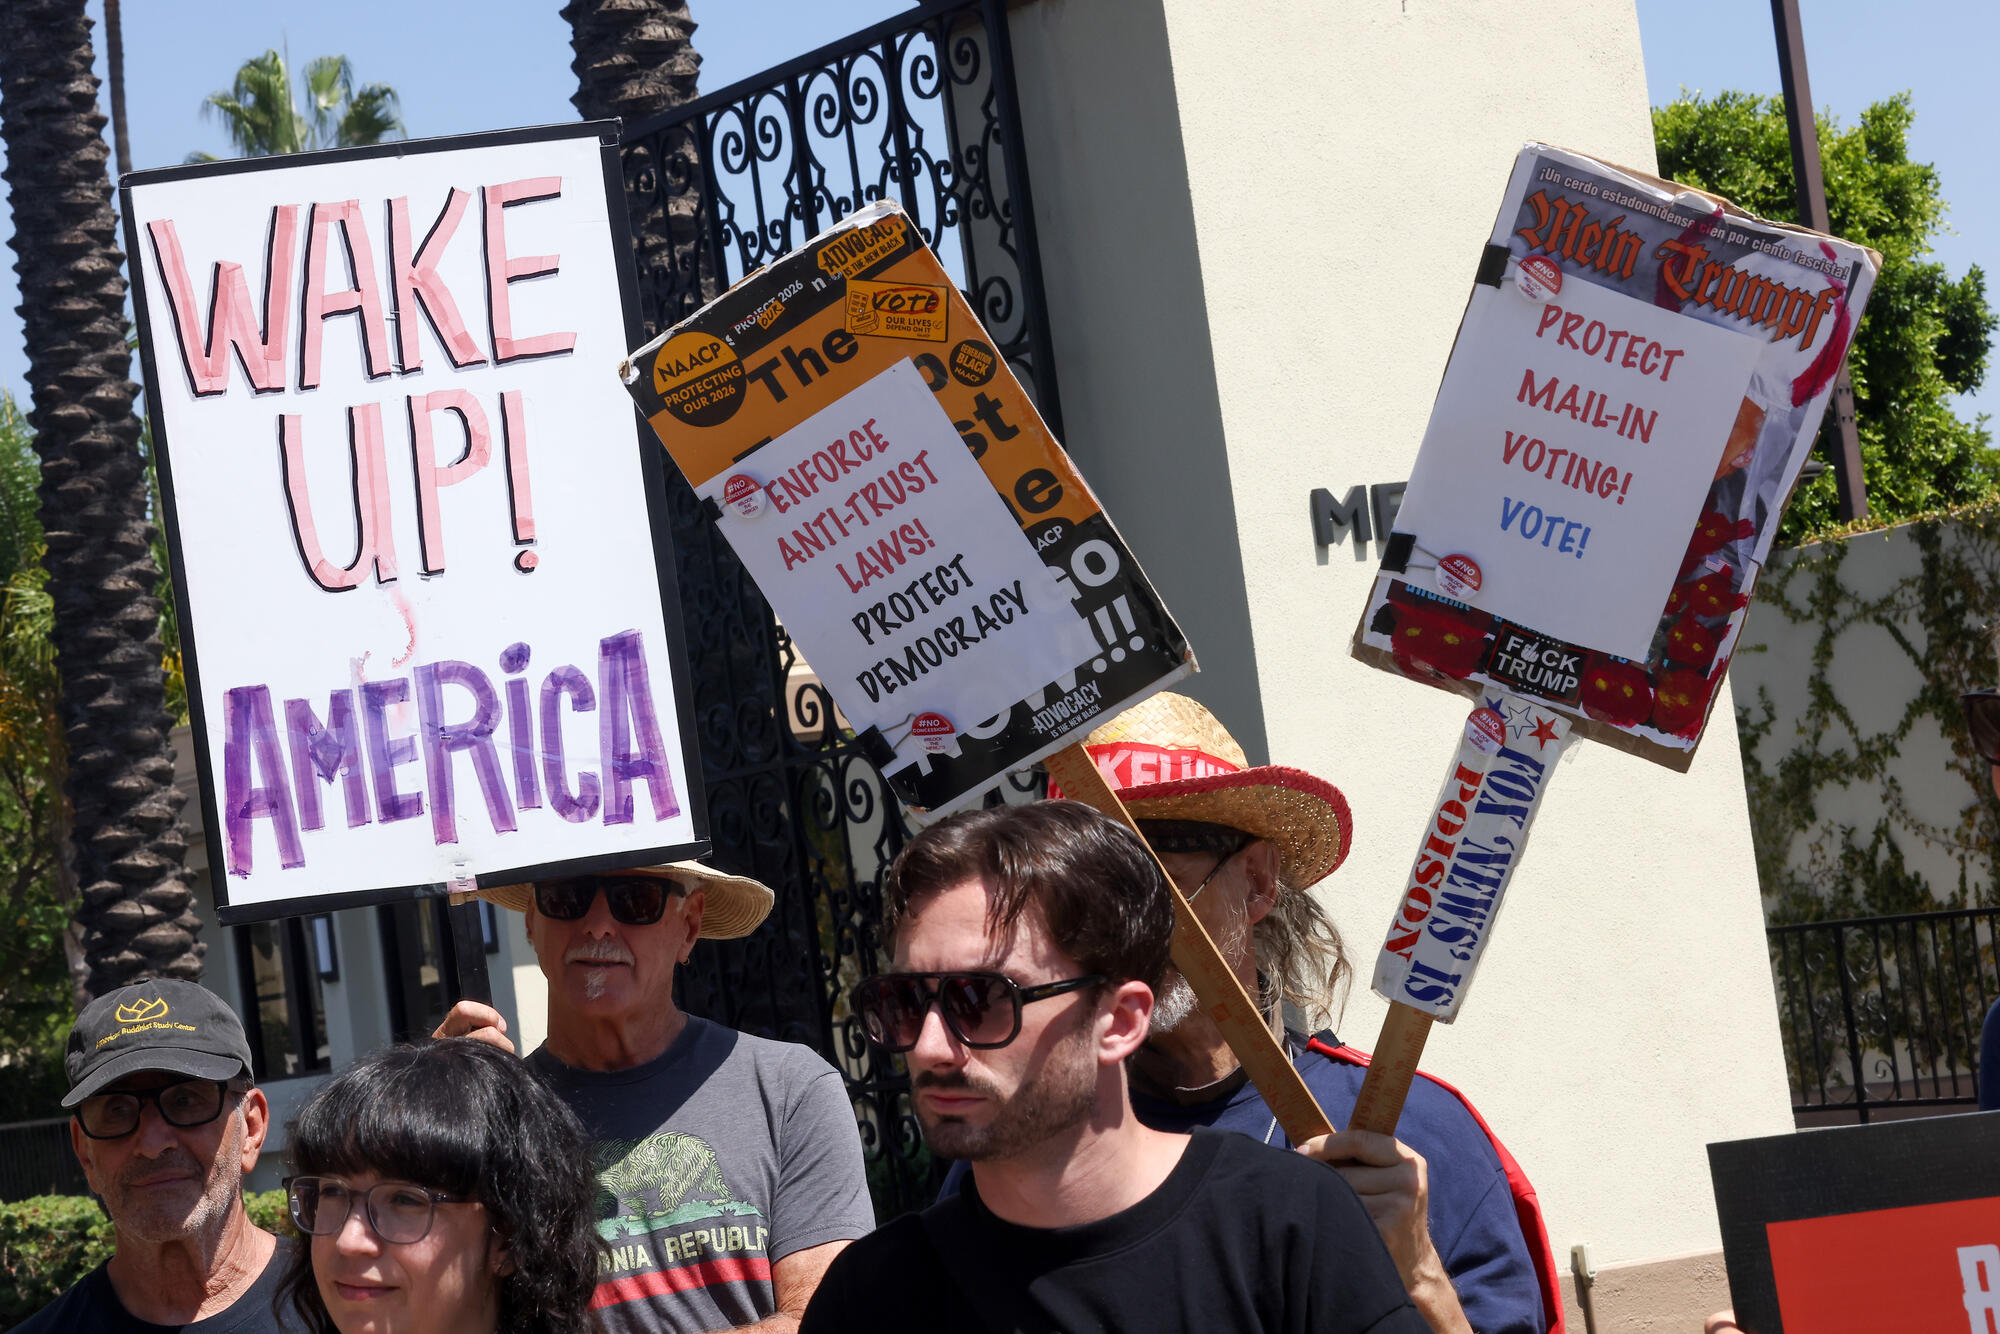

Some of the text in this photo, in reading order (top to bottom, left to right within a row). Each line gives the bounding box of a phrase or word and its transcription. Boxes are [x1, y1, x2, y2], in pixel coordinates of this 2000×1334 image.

[1539, 167, 1562, 185] ¡Un
[1564, 176, 1599, 196] cerdo
[1601, 187, 1696, 231] estadounidense
[1727, 229, 1751, 246] por
[1751, 237, 1791, 261] ciento
[1794, 249, 1851, 281] fascista!
[843, 236, 901, 277] IS THE NEW BLACK
[1515, 188, 1846, 353] Mein Trumpf
[147, 176, 578, 397] WAKE
[777, 279, 804, 303] 2026
[872, 291, 938, 314] VOTE
[761, 304, 784, 327] OUR
[886, 316, 932, 327] OUR LIVES
[886, 324, 911, 332] DEPEND
[657, 341, 721, 383] NAACP
[956, 352, 989, 377] BLACK
[1535, 304, 1685, 382] PROTECT
[664, 364, 742, 408] PROTECTING
[747, 328, 860, 404] The
[954, 366, 981, 383] NAACP
[683, 384, 736, 414] OUR 2026
[1516, 369, 1659, 444] MAIL-IN
[726, 479, 746, 493] #NO
[764, 418, 890, 514] ENFORCE
[1502, 430, 1634, 505] VOTING!
[278, 389, 540, 592] UP!
[776, 449, 939, 571] ANTI-TRUST
[1036, 525, 1064, 553] ACP
[1500, 496, 1592, 560] VOTE!
[835, 518, 936, 594] LAWS!
[1452, 558, 1476, 576] #NO
[851, 554, 974, 645] PROTECT
[855, 580, 1030, 704] DEMOCRACY
[1498, 652, 1579, 694] TRUMP
[918, 719, 939, 727] #NO
[1032, 680, 1103, 735] ADVOCACY
[1050, 703, 1102, 739] IS THE NEW BLACK
[1478, 711, 1500, 730] #NO
[1474, 746, 1545, 830] FOX
[1385, 761, 1485, 963] POISON
[1404, 960, 1462, 1006] IS
[122, 1022, 153, 1035] Buddhist
[153, 1021, 173, 1030] Study
[174, 1022, 196, 1032] Center
